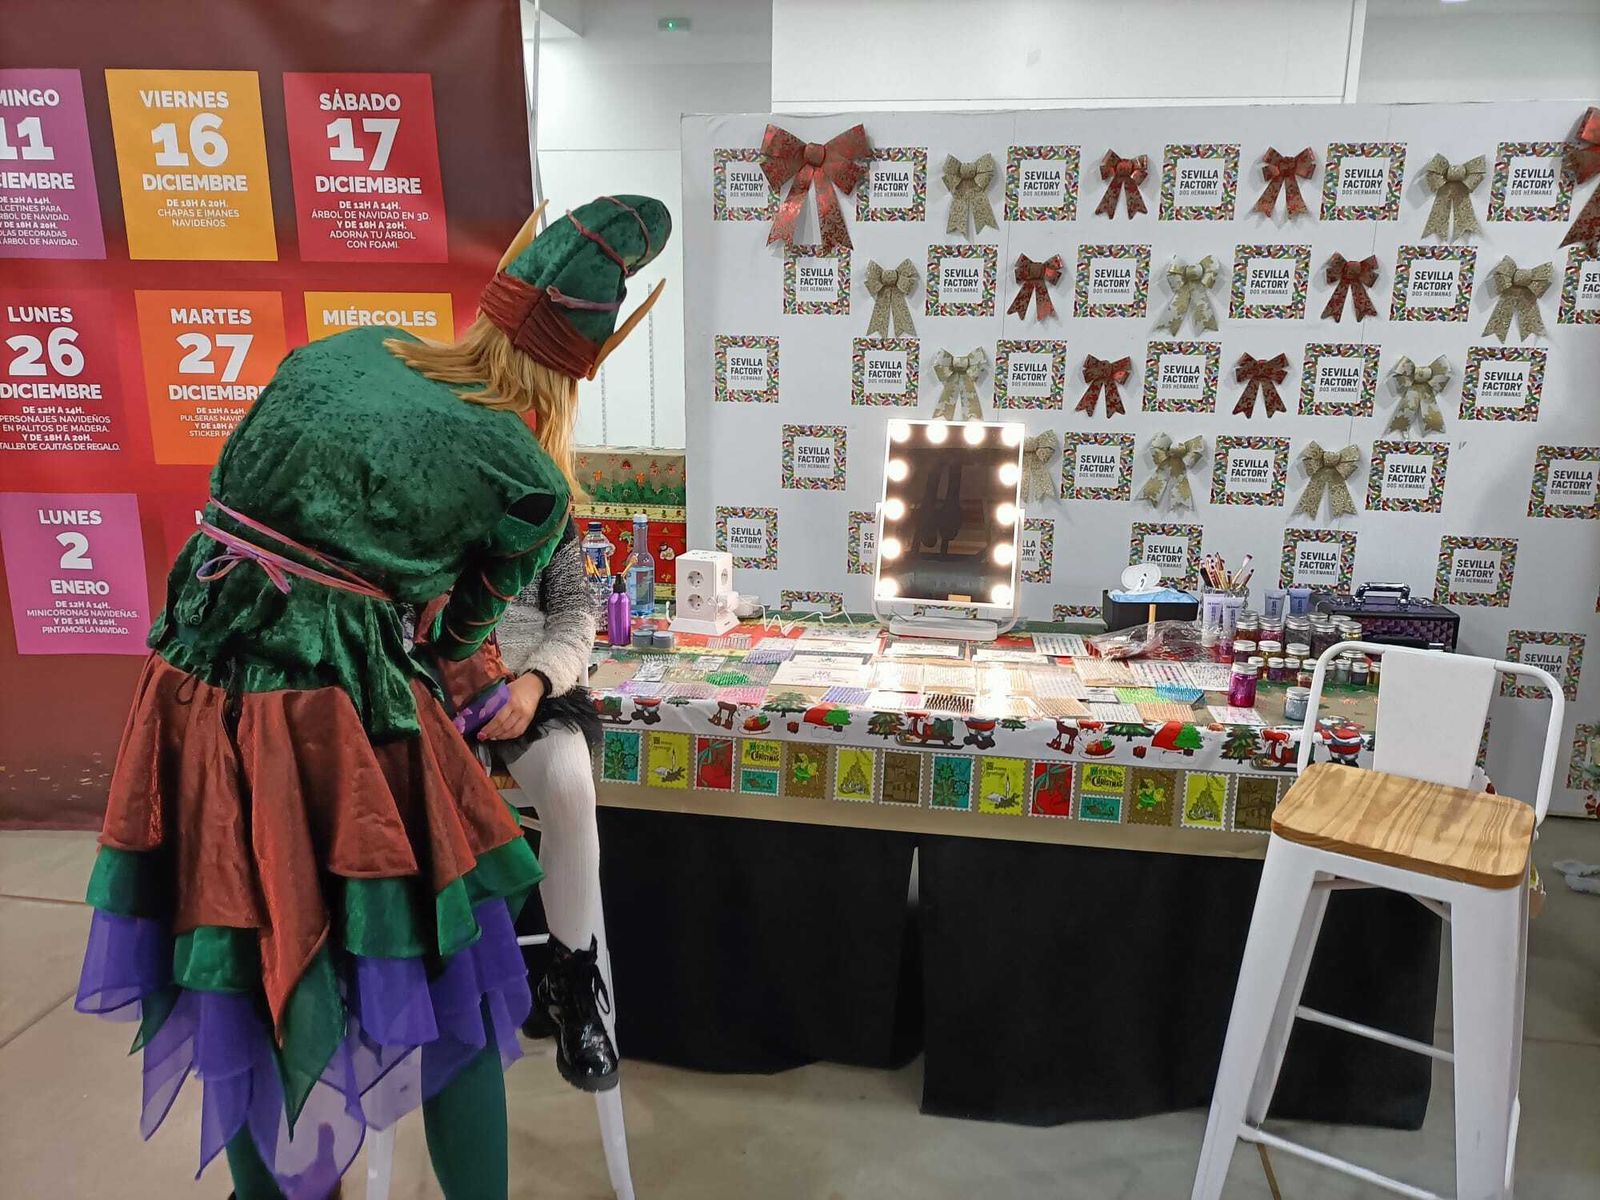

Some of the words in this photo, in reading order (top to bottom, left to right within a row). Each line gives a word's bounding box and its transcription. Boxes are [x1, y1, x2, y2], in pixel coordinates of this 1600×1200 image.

[139, 90, 229, 109] VIERNES
[319, 89, 401, 111] SÁBADO
[151, 113, 229, 168] 16
[326, 118, 401, 171] 17
[730, 172, 764, 182] SEVILLA
[874, 172, 909, 182] SEVILLA
[1024, 171, 1060, 180] SEVILLA
[1181, 170, 1219, 179] SEVILLA
[1344, 169, 1384, 178] SEVILLA
[1514, 169, 1555, 178] SEVILLA
[0, 172, 75, 189] IEMBRE
[143, 174, 248, 192] DICIEMBRE
[315, 176, 422, 194] DICIEMBRE
[1180, 180, 1218, 189] FACTORY
[1343, 180, 1383, 188] FACTORY
[1512, 180, 1554, 189] FACTORY
[730, 183, 764, 191] FACTORY
[873, 182, 909, 191] FACTORY
[1024, 181, 1060, 190] FACTORY
[381, 202, 401, 210] 14H.
[312, 209, 342, 218] ÁRBOL
[359, 211, 399, 219] NAVIDAD
[417, 212, 431, 221] 3D.
[384, 229, 416, 239] ÁRBOL
[800, 268, 834, 277] SEVILLA
[944, 268, 979, 278] SEVILLA
[1094, 269, 1131, 278] SEVILLA
[1252, 269, 1290, 279] SEVILLA
[1414, 271, 1453, 281] SEVILLA
[800, 278, 834, 286] FACTORY
[944, 279, 979, 287] FACTORY
[1093, 279, 1130, 288] FACTORY
[1250, 280, 1289, 289] FACTORY
[1412, 281, 1453, 290] FACTORY
[7, 307, 73, 324] LUNES
[171, 308, 252, 326] MARTES
[322, 306, 437, 327] MIÉRCOLES
[5, 327, 85, 377] 26
[176, 333, 254, 382] 27
[731, 357, 763, 367] SEVILLA
[869, 360, 902, 370] SEVILLA
[1013, 363, 1048, 372] SEVILLA
[1164, 365, 1200, 374] SEVILLA
[730, 367, 763, 375] FACTORY
[868, 370, 902, 378] FACTORY
[1321, 367, 1360, 377] SEVILLA
[1012, 372, 1047, 381] FACTORY
[1162, 375, 1200, 383] FACTORY
[1484, 371, 1523, 382] SEVILLA
[1320, 378, 1359, 386] FACTORY
[1482, 382, 1523, 391] FACTORY
[0, 383, 102, 400] DICIEMBRE
[60, 414, 111, 423] NAVIDEÑOS
[798, 446, 830, 455] SEVILLA
[798, 455, 830, 464] FACTORY
[1080, 455, 1116, 464] SEVILLA
[1232, 459, 1269, 469] SEVILLA
[1079, 464, 1115, 473] FACTORY
[1231, 468, 1268, 478] FACTORY
[1389, 464, 1427, 474] SEVILLA
[1387, 474, 1426, 483] FACTORY
[1553, 470, 1593, 481] SEVILLA
[1551, 480, 1592, 490] FACTORY
[38, 510, 102, 525] LUNES
[731, 527, 762, 536] SEVILLA
[731, 536, 762, 544] FACTORY
[56, 532, 93, 570] 2
[1147, 544, 1183, 555] SEVILLA
[1146, 554, 1183, 563] FACTORY
[1300, 551, 1338, 562] SEVILLA
[1299, 561, 1337, 570] FACTORY
[1457, 559, 1495, 570] SEVILLA
[1455, 568, 1494, 578] FACTORY
[51, 580, 110, 595] ENERO
[1524, 654, 1562, 663] SEVILLA
